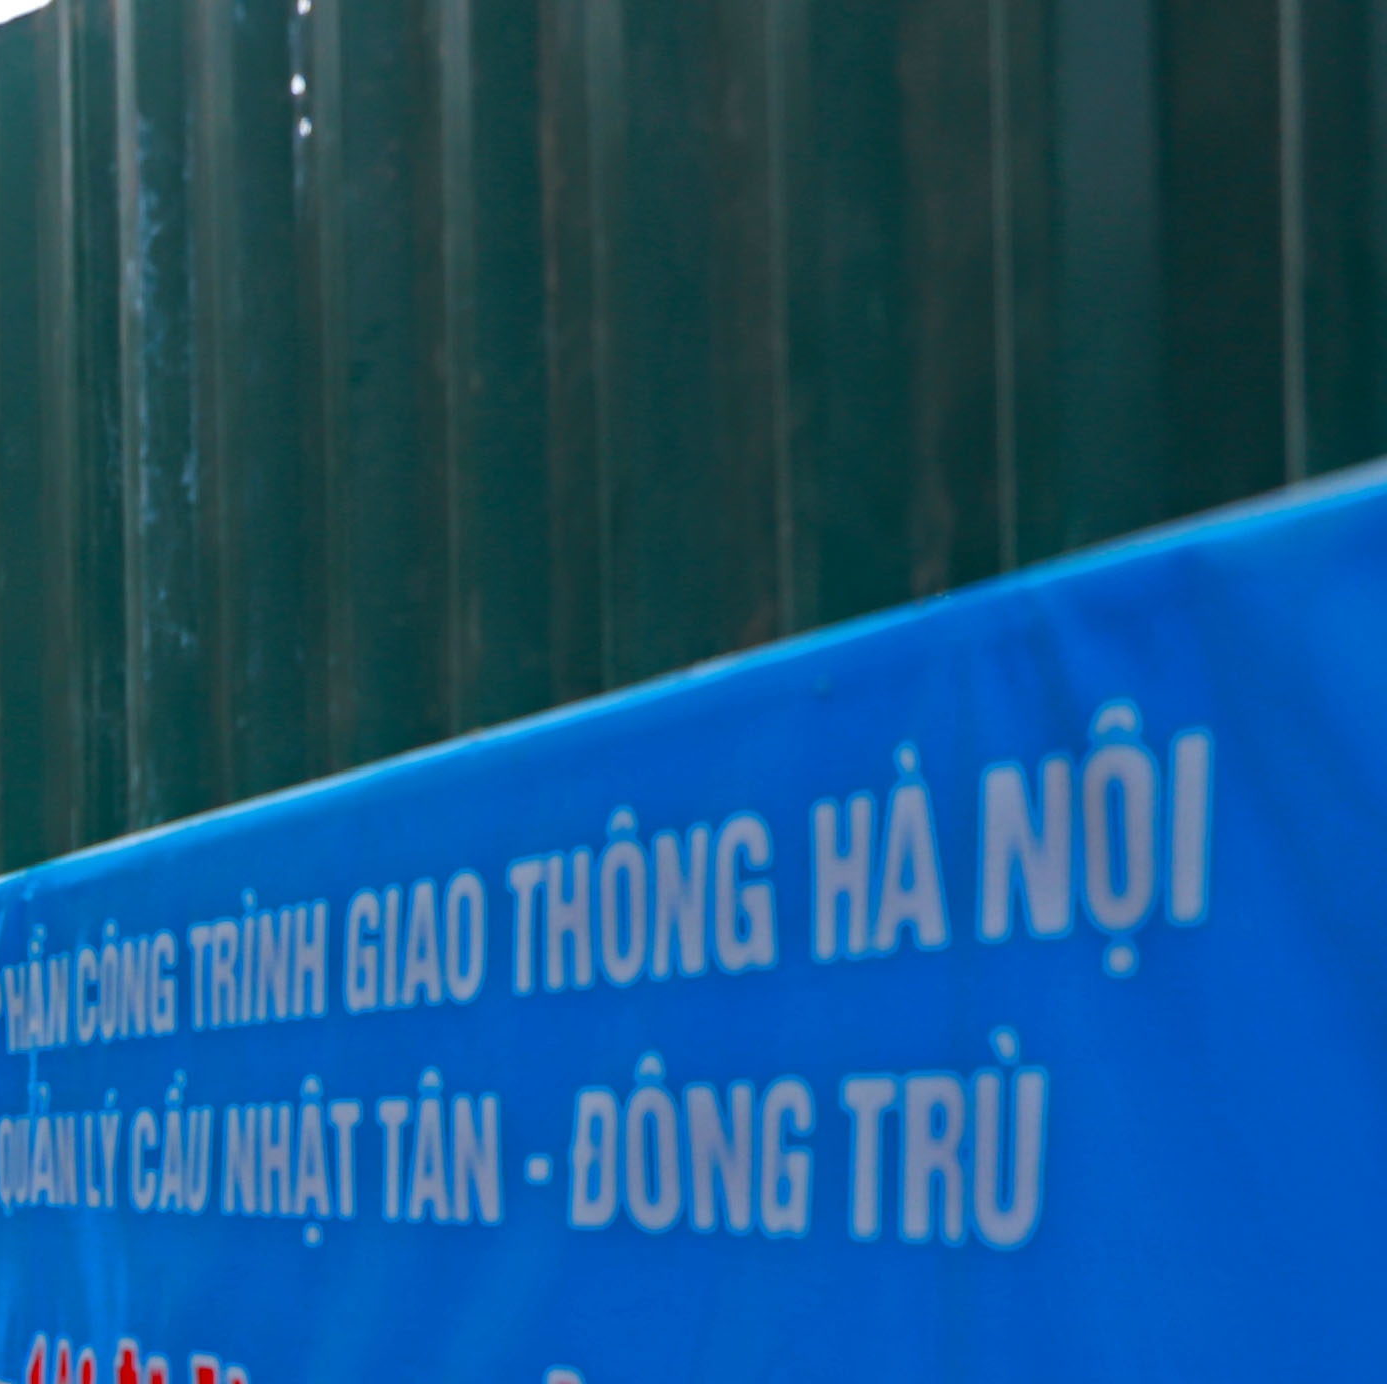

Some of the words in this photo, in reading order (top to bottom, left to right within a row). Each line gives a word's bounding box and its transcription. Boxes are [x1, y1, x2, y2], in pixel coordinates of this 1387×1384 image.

[76, 921, 176, 1043] CÔNG
[190, 889, 327, 1030] TRÌNH
[344, 871, 486, 1015] GIAO
[509, 808, 776, 994] THÔNG
[813, 745, 948, 962] HÀ
[980, 703, 1212, 975] NỘI
[85, 1089, 122, 1208] LÝ
[222, 1076, 361, 1245] NHẬT
[378, 1069, 502, 1224] TÂN
[568, 1054, 813, 1238] ĐÔNG
[842, 1030, 1047, 1249] TRÙ
